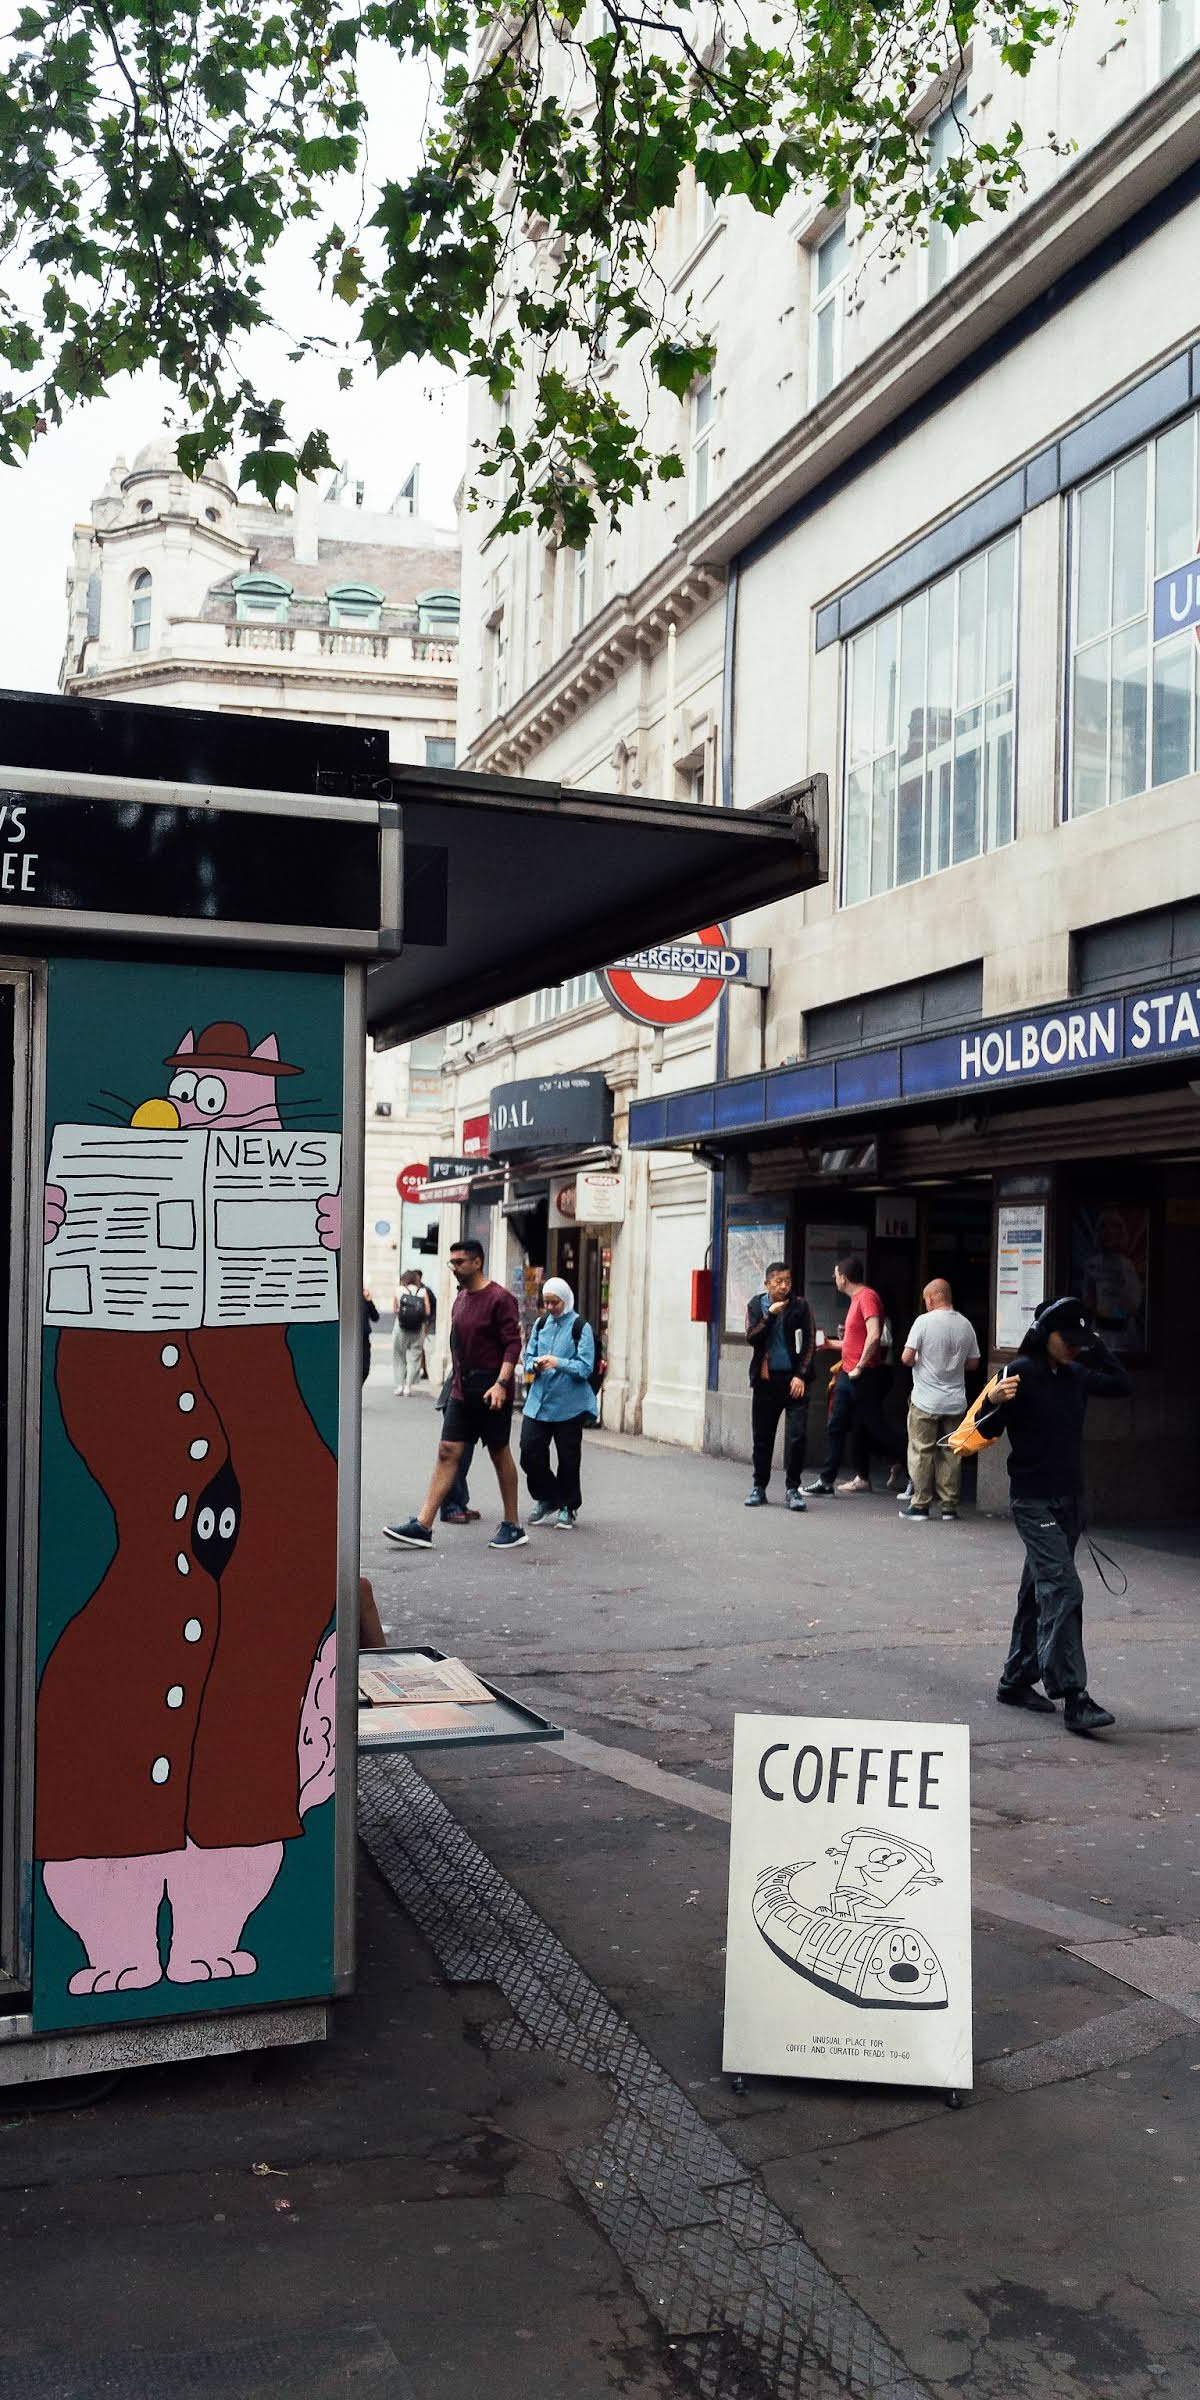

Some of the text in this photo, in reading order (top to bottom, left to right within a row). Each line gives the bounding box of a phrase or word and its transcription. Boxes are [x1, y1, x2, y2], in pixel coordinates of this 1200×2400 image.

[625, 948, 741, 976] ERGROUND
[960, 988, 1200, 1080] HOLBORN STA
[493, 1100, 535, 1132] DAL
[216, 1134, 327, 1168] NEWS
[758, 1743, 944, 1810] COFFEE
[785, 2044, 911, 2060] COFFEE AND CURATED READS TO-GO
[812, 2035, 884, 2048] UNUSUAL PLACE FOR
